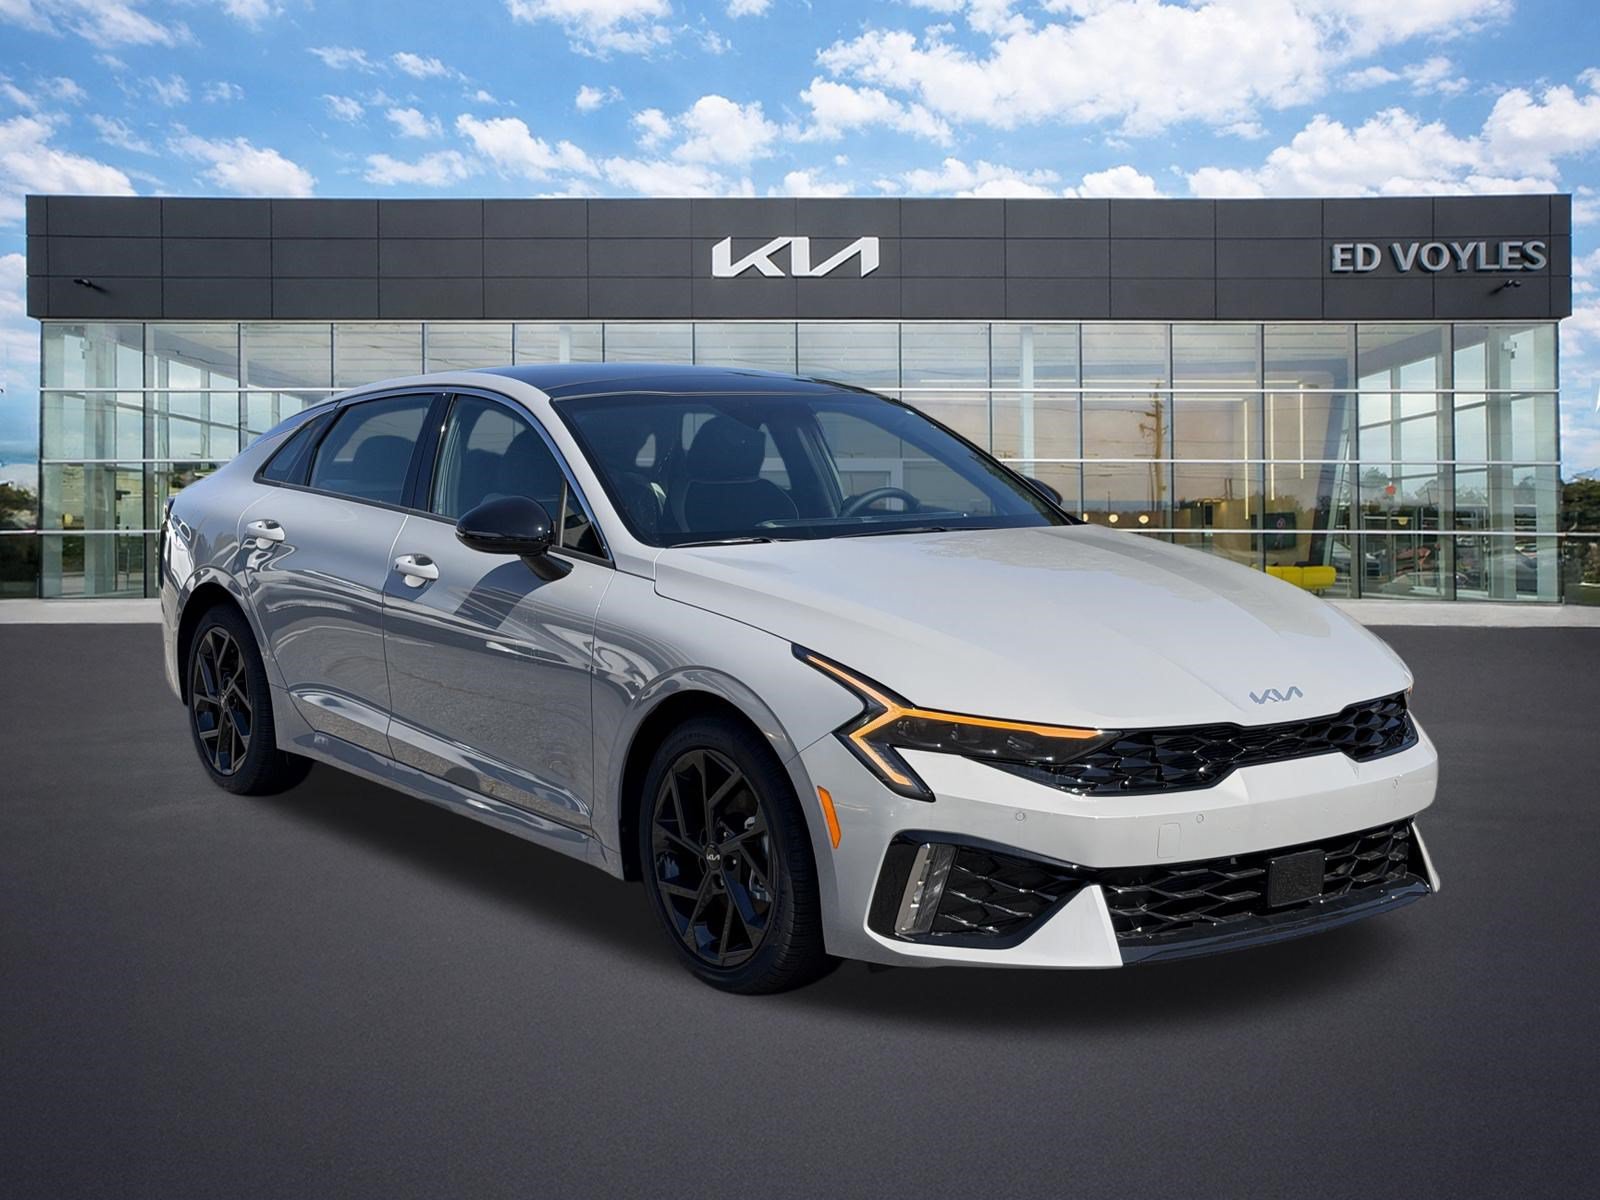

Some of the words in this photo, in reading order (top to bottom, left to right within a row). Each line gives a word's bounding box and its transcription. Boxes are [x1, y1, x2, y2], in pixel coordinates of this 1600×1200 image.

[712, 236, 880, 278] KIA
[1332, 243, 1382, 272] ED
[1391, 240, 1547, 273] VOYLES
[1249, 686, 1303, 704] KIA
